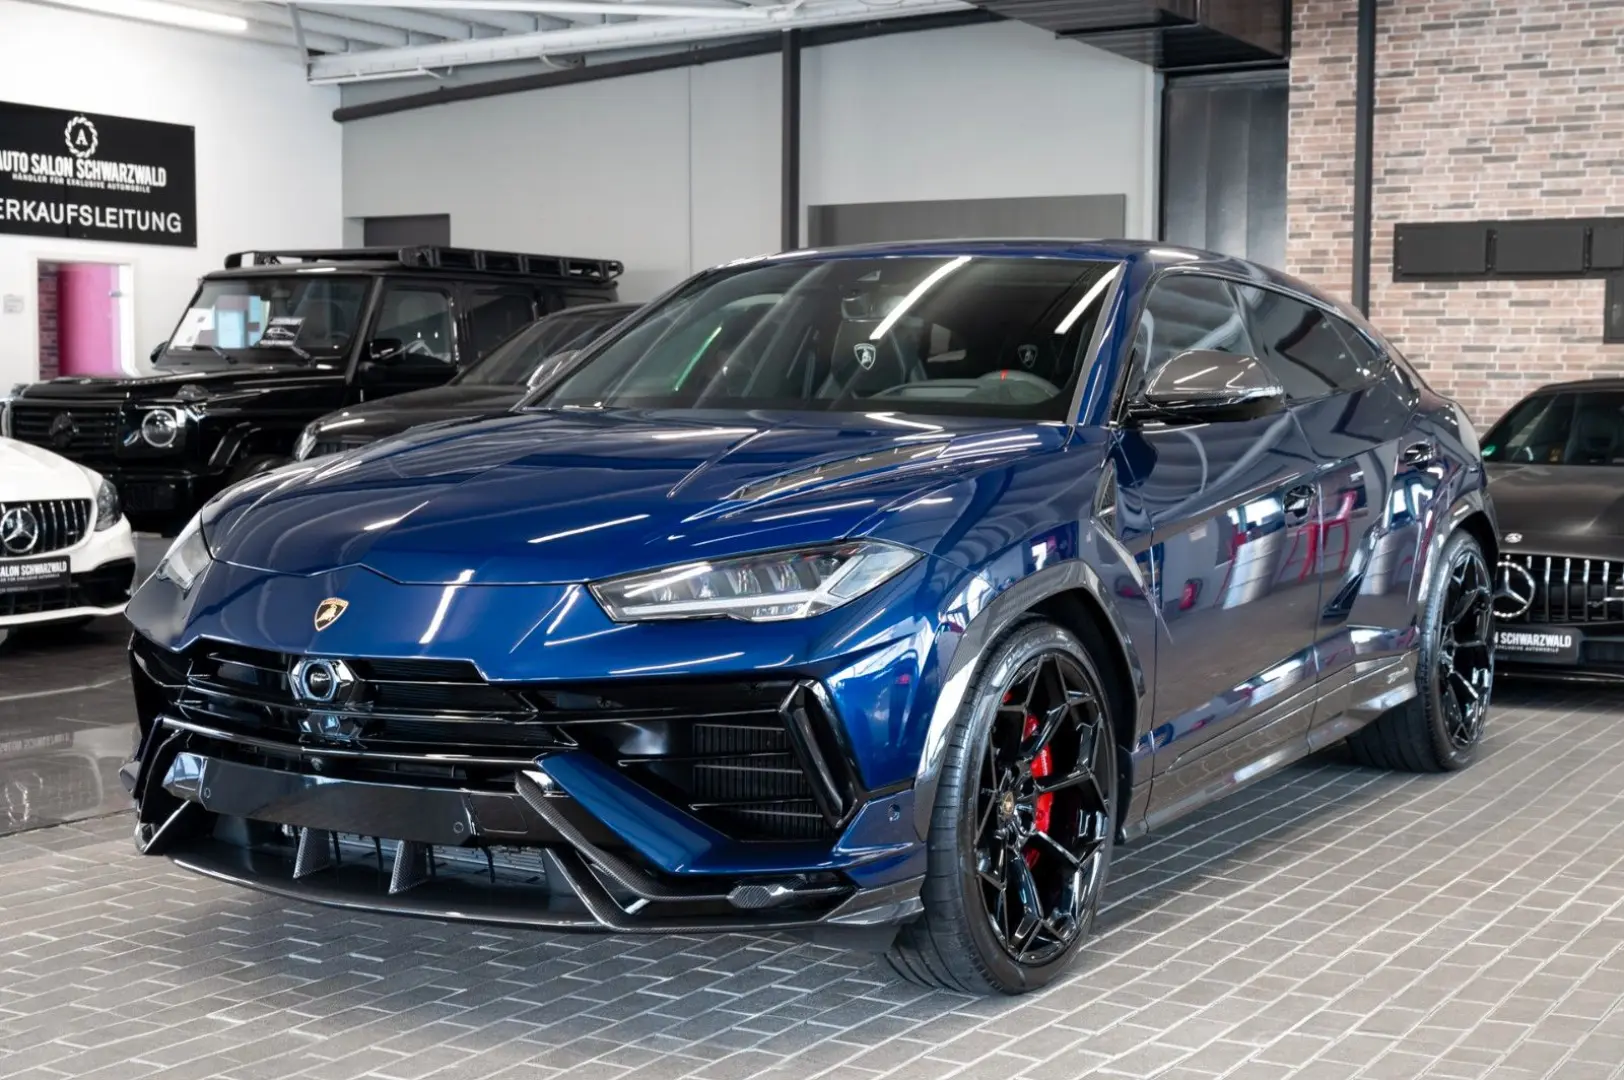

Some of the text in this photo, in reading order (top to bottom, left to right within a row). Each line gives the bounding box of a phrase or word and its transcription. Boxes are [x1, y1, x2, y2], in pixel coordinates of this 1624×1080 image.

[75, 128, 88, 146] A
[31, 153, 73, 178] SALON
[76, 158, 167, 187] SCHWARZWALD
[1501, 632, 1572, 648] SCHWARZWALD
